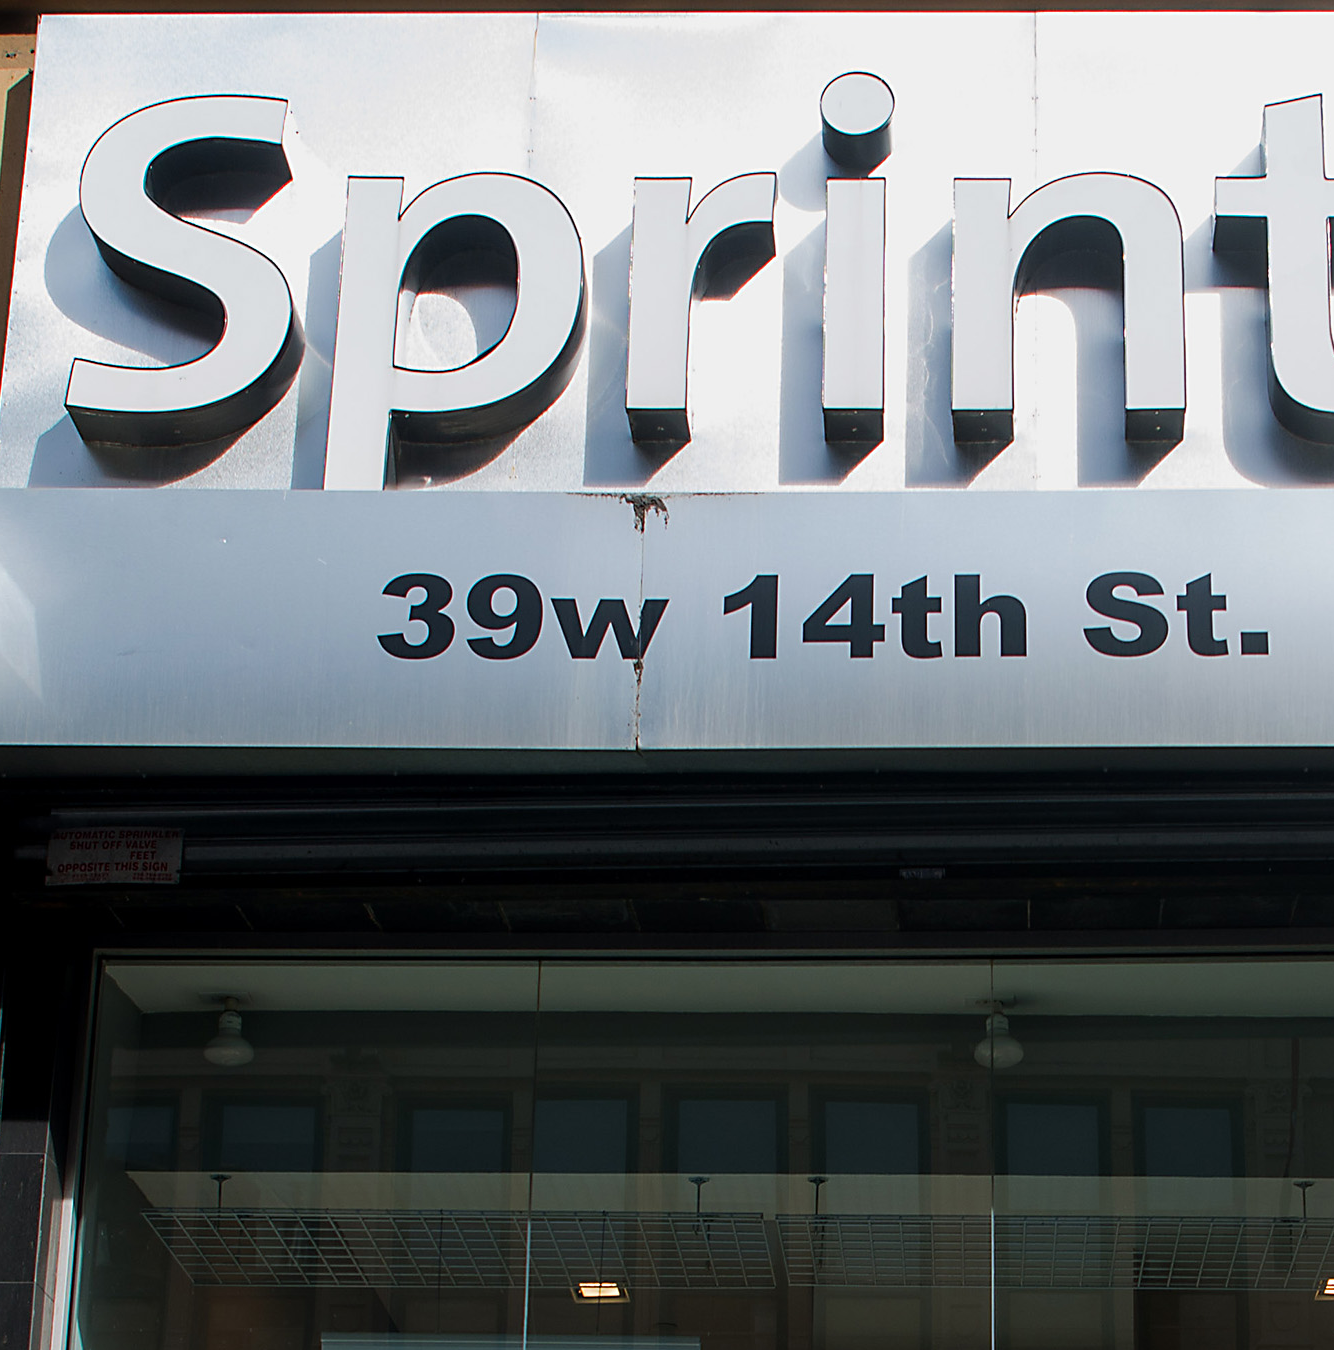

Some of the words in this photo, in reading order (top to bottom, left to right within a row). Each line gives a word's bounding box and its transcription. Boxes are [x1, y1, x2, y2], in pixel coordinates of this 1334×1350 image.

[376, 571, 670, 661] 39w
[722, 570, 1028, 661] 14th
[1083, 570, 1271, 660] St.
[53, 830, 116, 840] AUTOMATIC
[118, 829, 179, 839] SPRINKLER
[70, 841, 100, 850] SHUT
[102, 840, 122, 849] OFF
[125, 840, 157, 849] VALVE
[130, 851, 157, 860] FEET
[57, 863, 110, 873] OPPOSITE
[115, 862, 139, 871] THIS
[142, 862, 168, 871] SIGN
